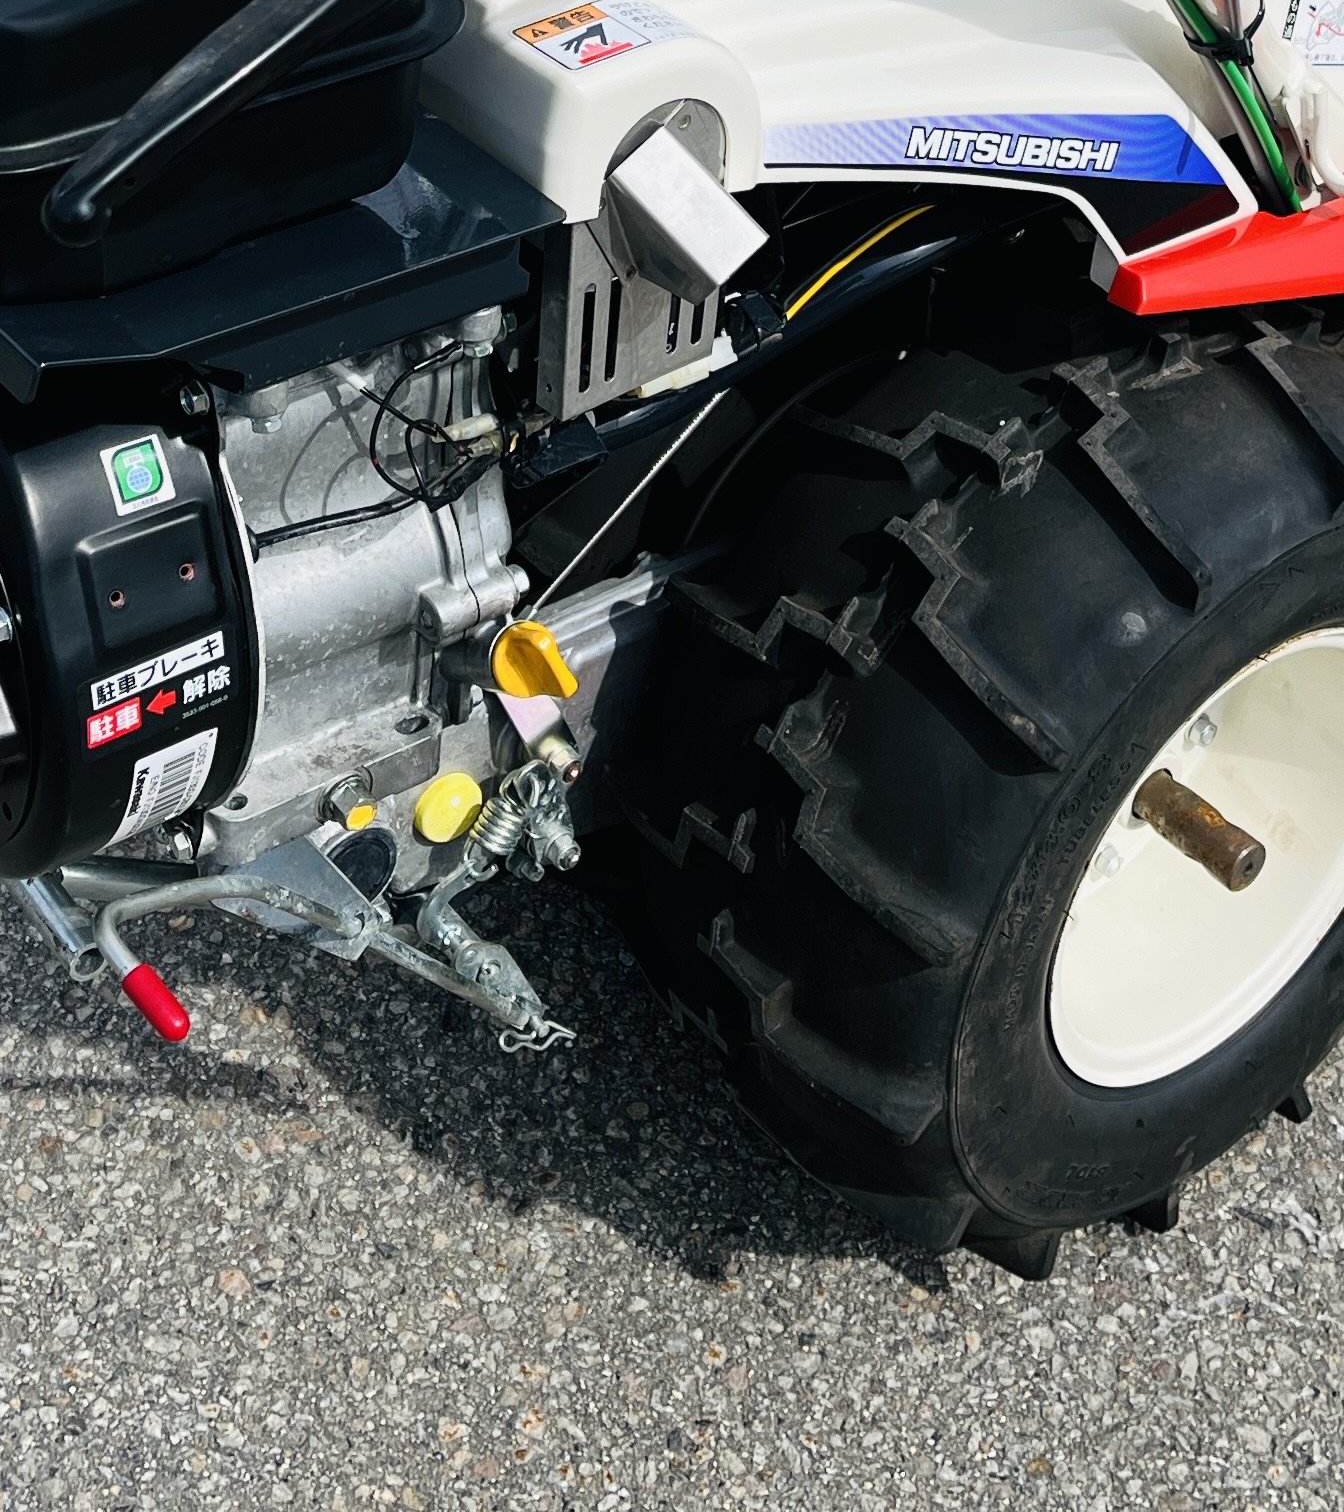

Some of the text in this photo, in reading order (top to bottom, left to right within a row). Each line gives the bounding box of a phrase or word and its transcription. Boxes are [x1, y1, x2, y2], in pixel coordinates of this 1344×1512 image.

[547, 10, 596, 30] 警告
[905, 125, 1121, 172] MITSUBISHI
[96, 639, 220, 706] 駐車ブレーキ
[182, 665, 232, 705] 解除
[89, 703, 140, 745] 駐車
